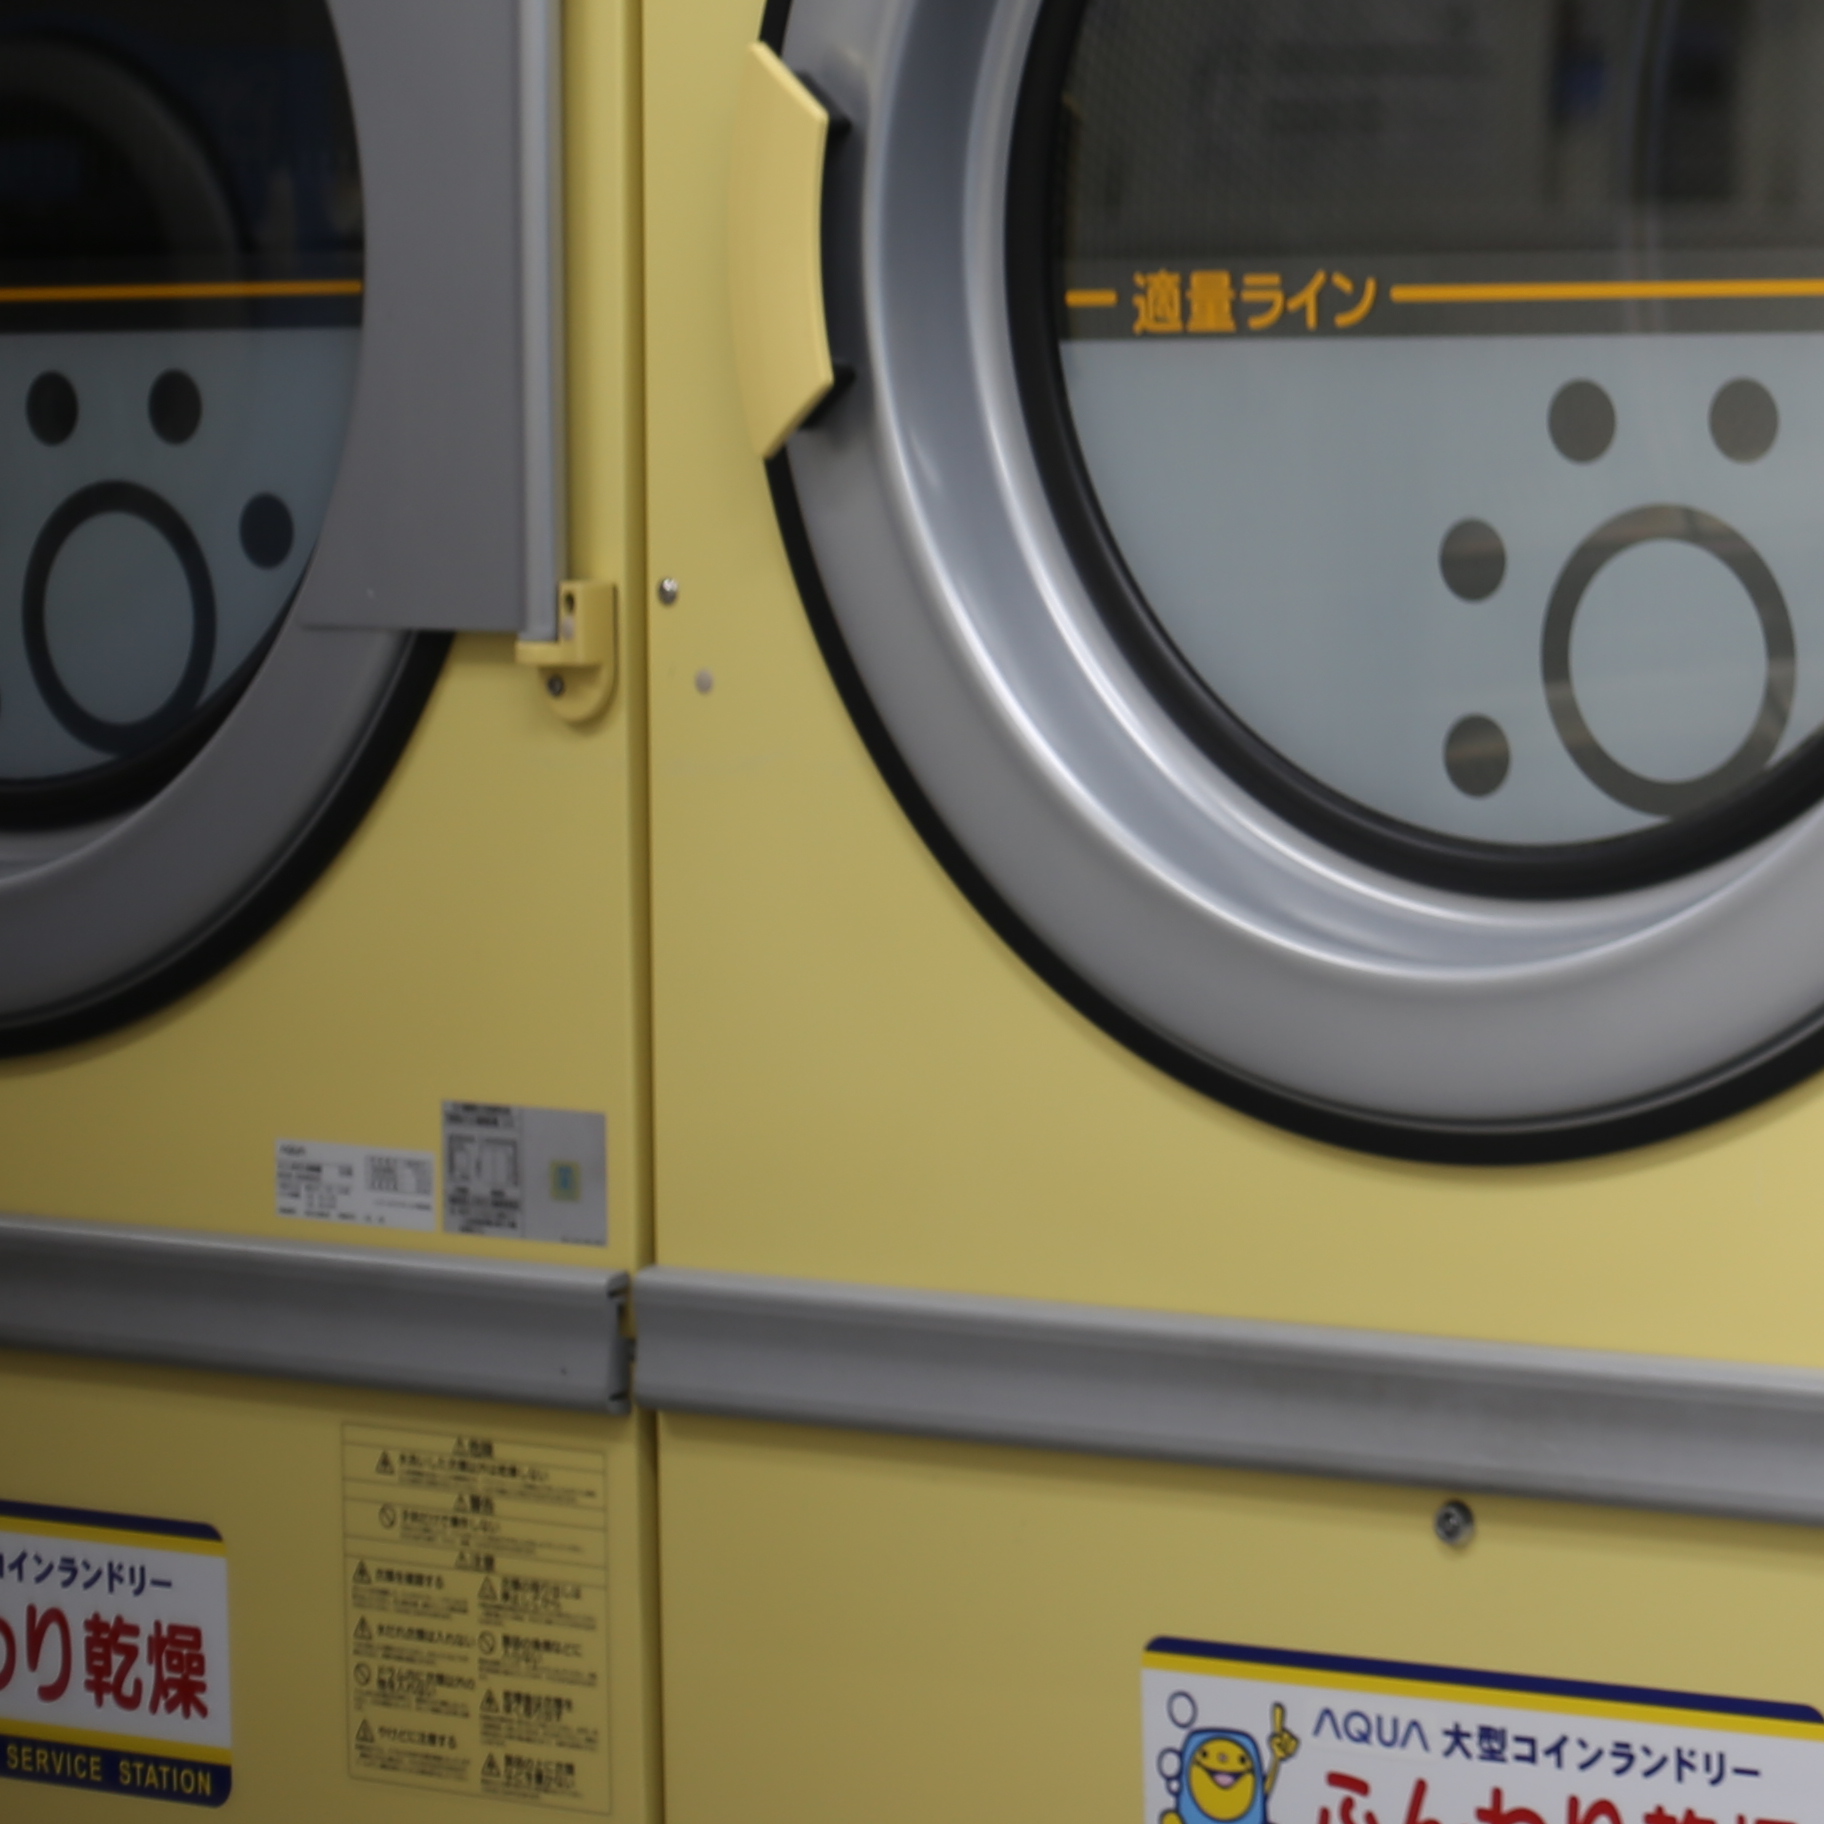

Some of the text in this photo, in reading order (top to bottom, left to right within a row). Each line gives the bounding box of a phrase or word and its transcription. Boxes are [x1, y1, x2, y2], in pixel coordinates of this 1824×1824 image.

[1133, 270, 1377, 336] 適量ライン
[0, 1549, 172, 1596] インランドリー
[7, 1744, 212, 1795] SERVICE STATION
[1313, 1707, 1760, 1786] AQUA 大型コインランドリー
